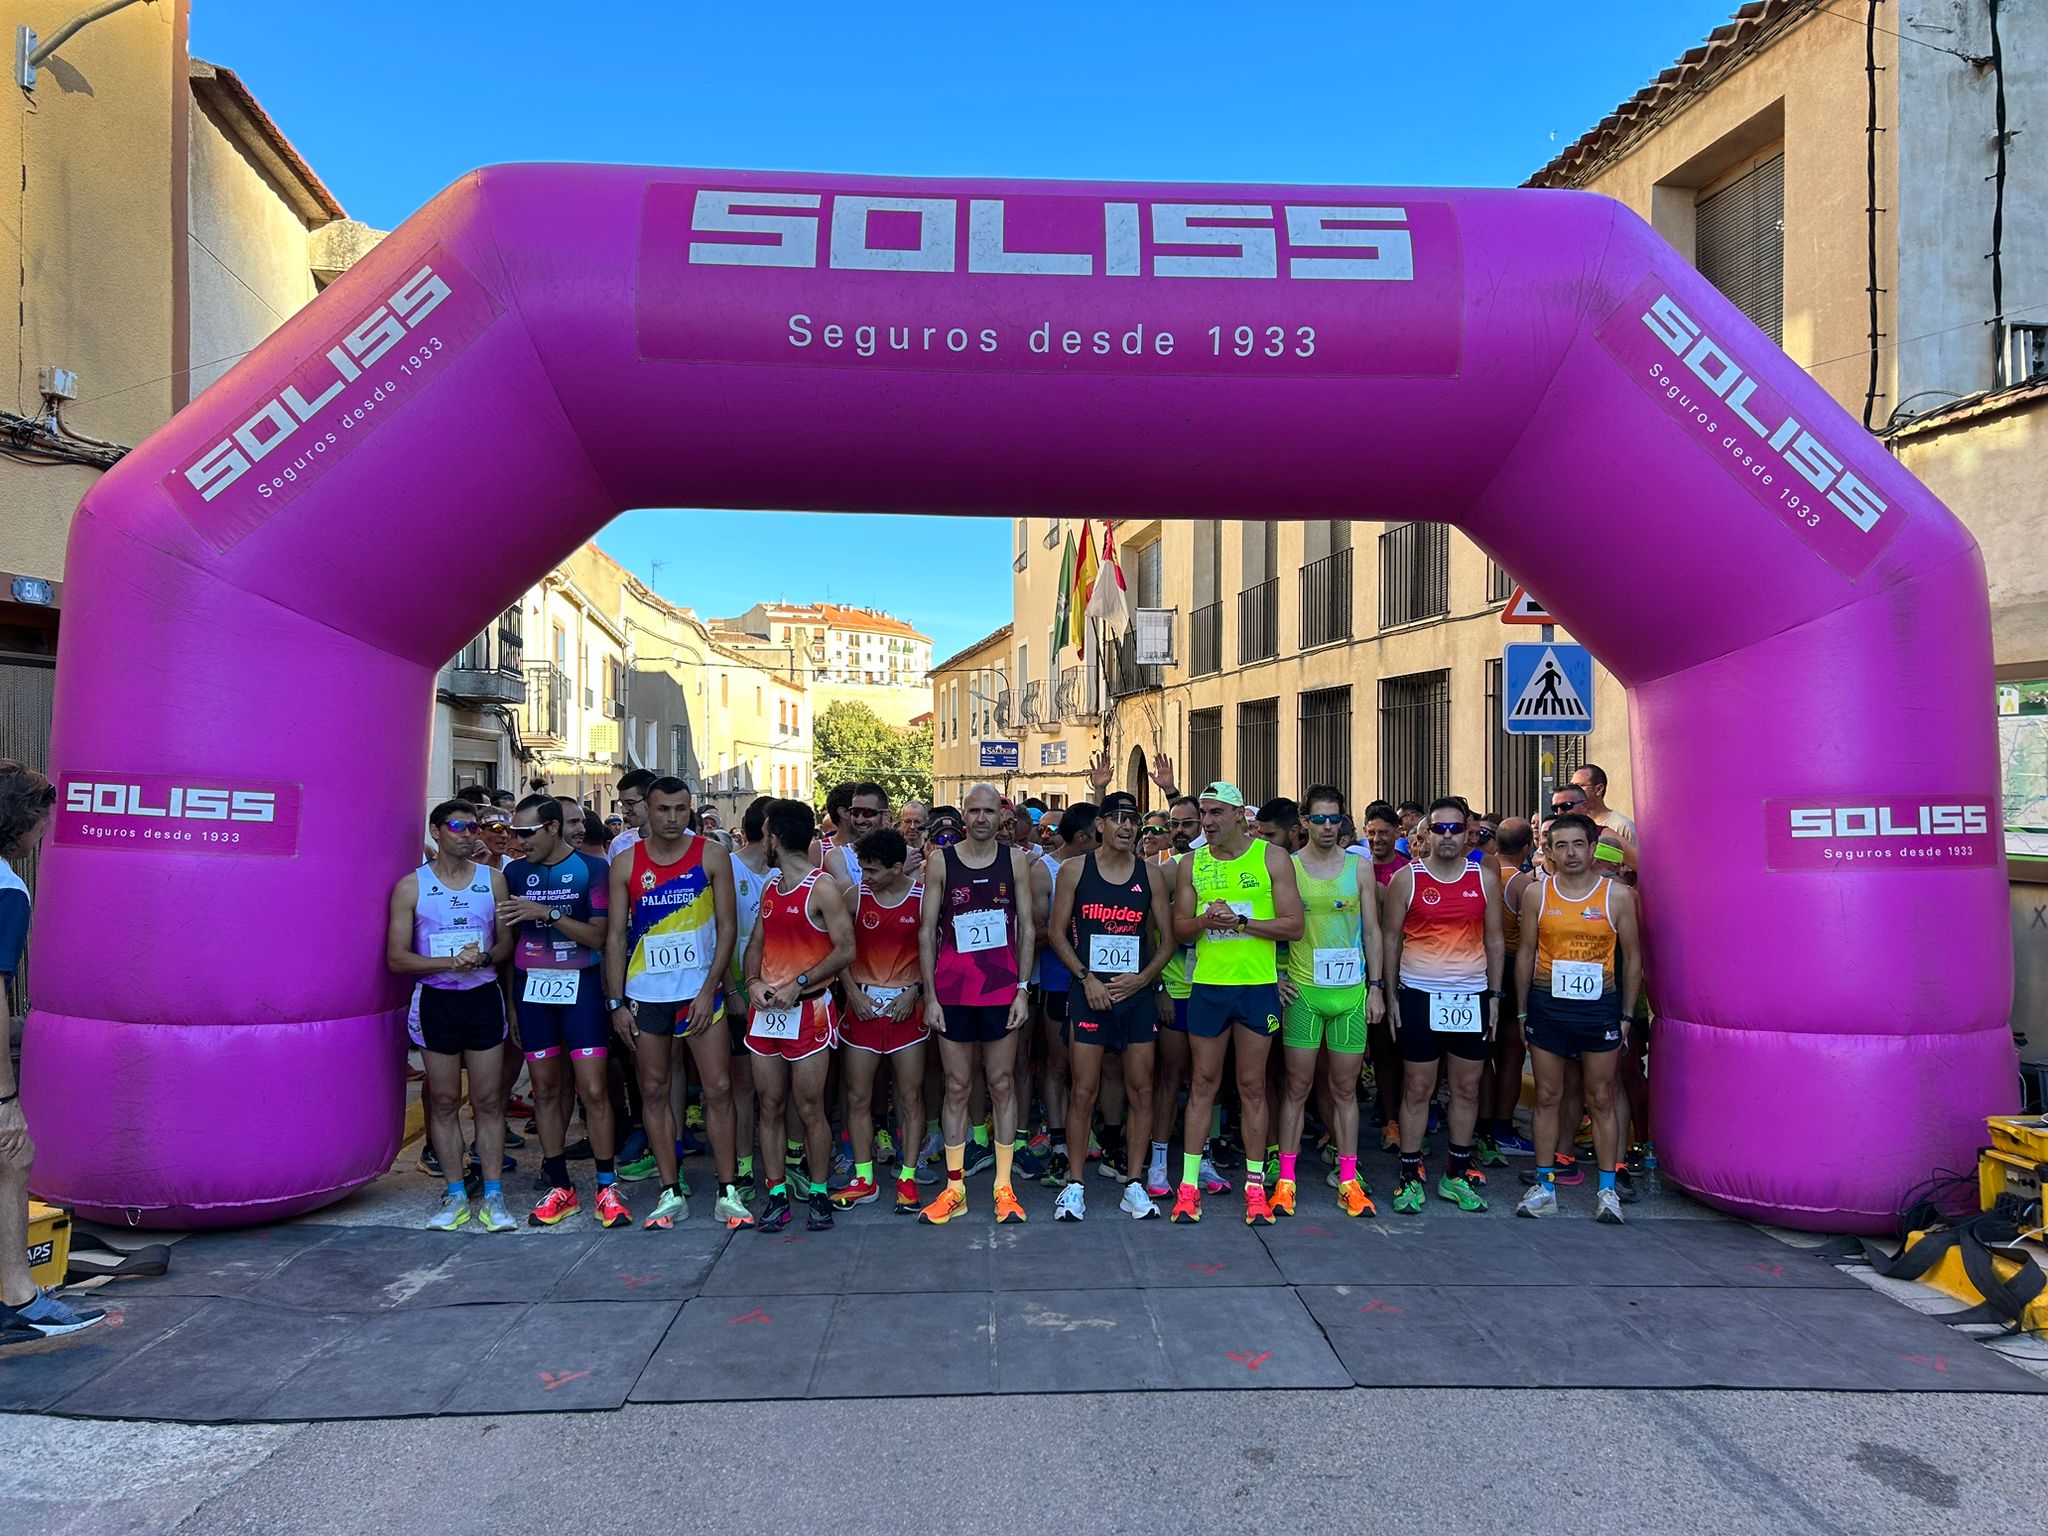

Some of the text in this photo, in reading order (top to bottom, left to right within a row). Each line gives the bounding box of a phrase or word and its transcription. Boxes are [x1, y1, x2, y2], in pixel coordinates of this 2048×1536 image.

[688, 190, 1415, 281] SOLISS
[788, 314, 1317, 357] Seguros desde 1933
[185, 265, 453, 502] SOLISS
[257, 336, 443, 499] Seguros desde 1933
[1642, 293, 1888, 533] SOLISS
[1648, 362, 1821, 527] Seguros desde 1933
[24, 581, 40, 599] 54
[66, 782, 276, 822] SOLISS
[1790, 805, 1988, 838] SOLISS
[82, 824, 241, 843] Seguros desde 1933
[1824, 846, 1974, 860] Seguros desde 1933
[642, 892, 695, 906] PALACIEGO
[1081, 903, 1143, 922] Filipides
[969, 926, 991, 945] 21
[650, 944, 695, 967] 1016
[1097, 948, 1131, 966] 204
[1325, 962, 1354, 979] 177
[530, 980, 575, 998] 1025
[1561, 975, 1594, 994] 140
[765, 1012, 787, 1032] 98
[1438, 1008, 1473, 1026] 309
